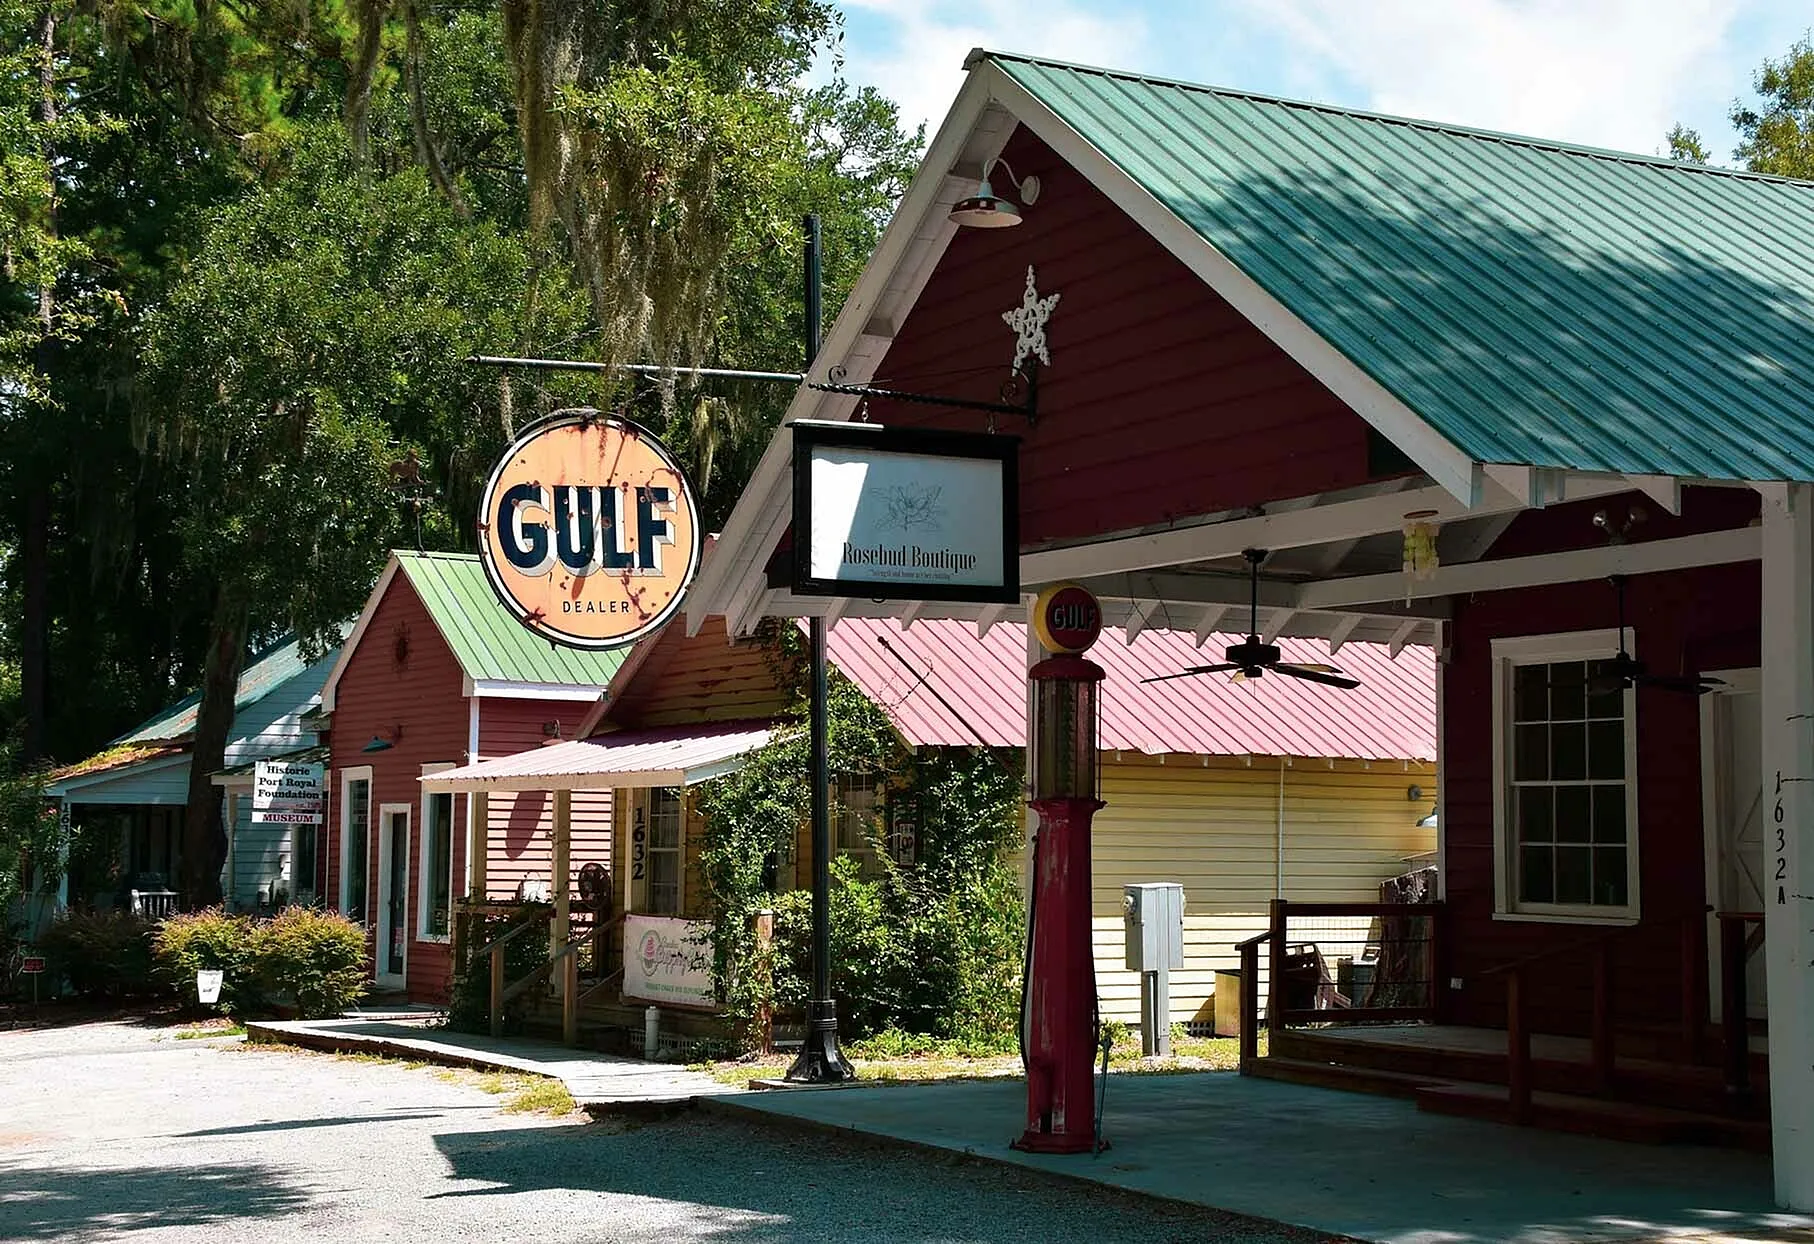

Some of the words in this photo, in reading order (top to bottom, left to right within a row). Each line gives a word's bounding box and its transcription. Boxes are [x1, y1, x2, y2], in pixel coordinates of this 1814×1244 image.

[497, 484, 676, 577] GULF
[843, 542, 906, 567] Rosebud
[911, 546, 976, 573] Boutique
[562, 601, 630, 613] DEALER
[1052, 604, 1096, 631] GULF
[267, 766, 310, 775] Historic
[259, 777, 282, 786] Port
[286, 778, 316, 788] Royal
[258, 789, 320, 799] Foundation
[262, 814, 313, 822] MUSEUM
[632, 807, 645, 880] 1632
[1774, 771, 1786, 904] 1632A
